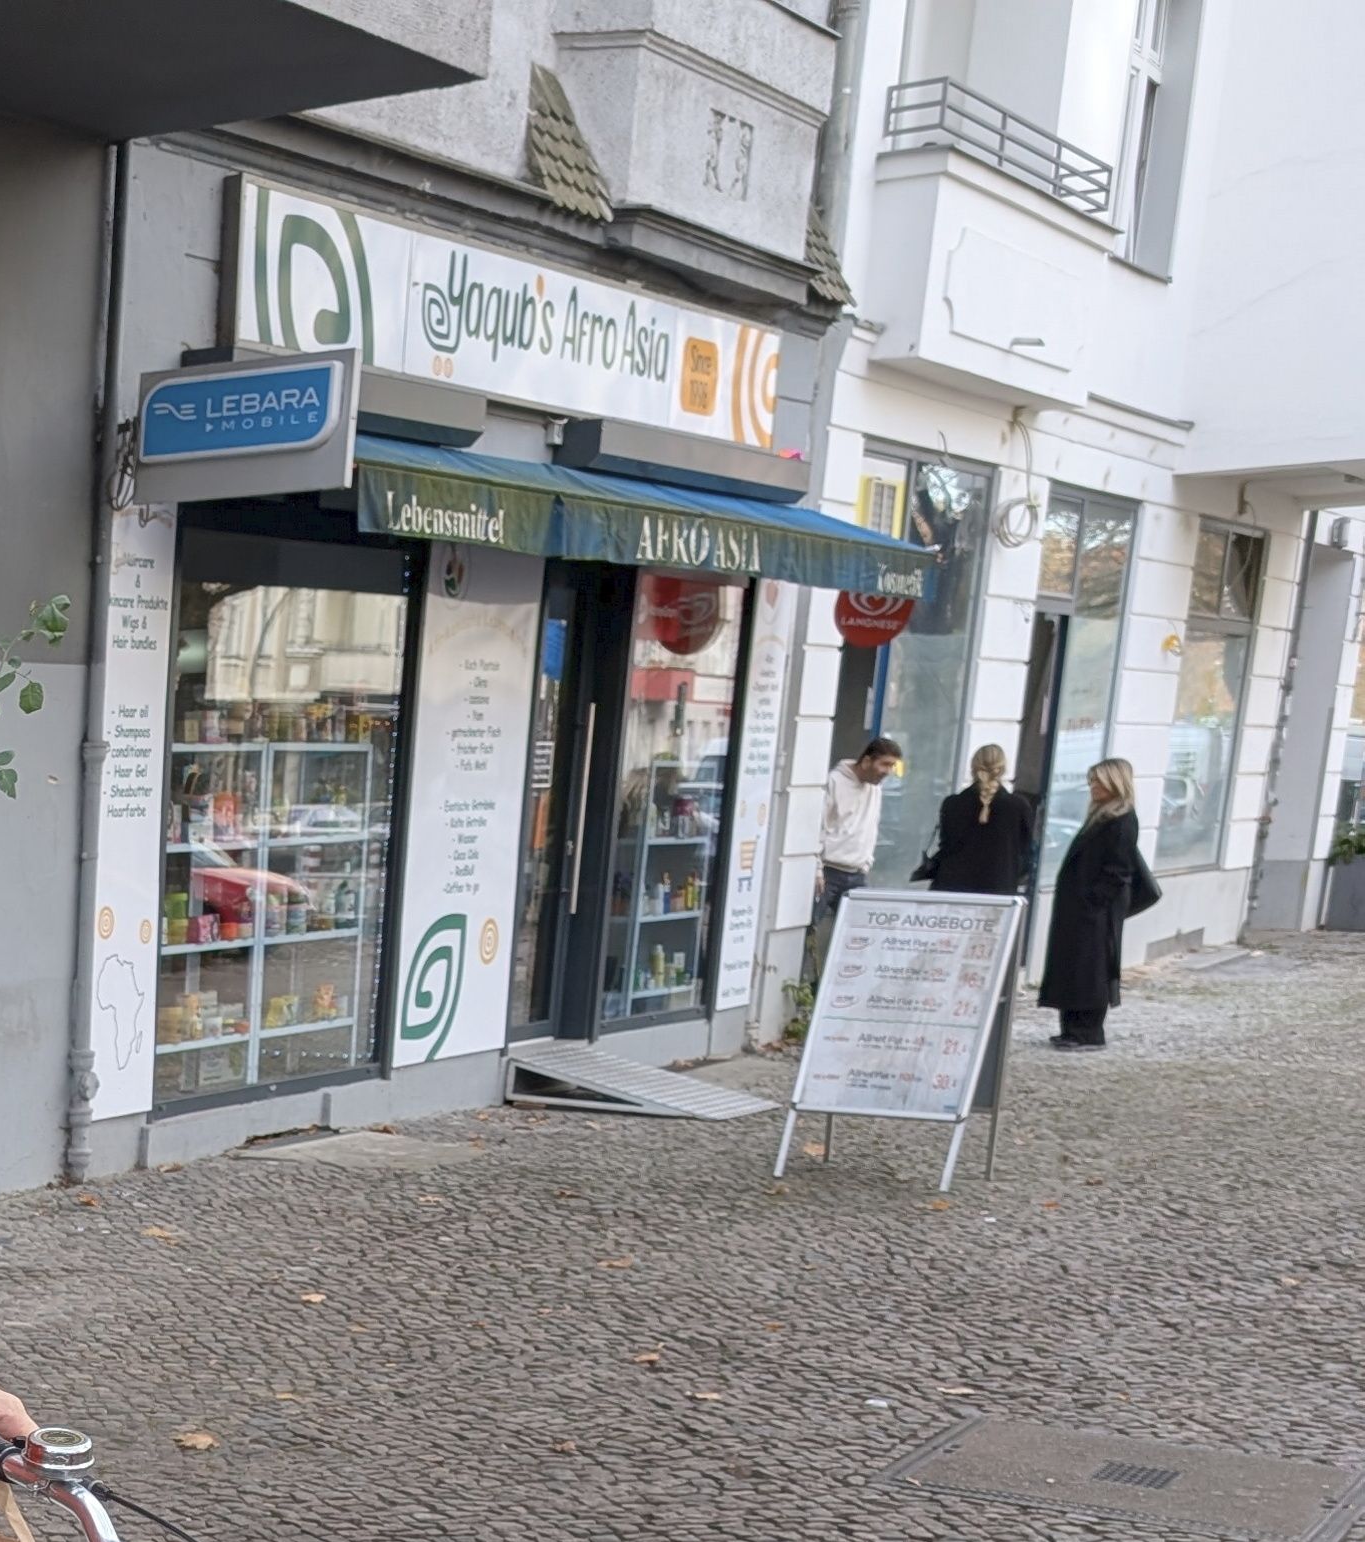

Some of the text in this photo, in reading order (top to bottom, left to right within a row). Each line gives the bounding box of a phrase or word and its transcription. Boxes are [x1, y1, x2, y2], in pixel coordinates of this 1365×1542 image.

[421, 250, 670, 383] Yaqub's Afro Asia
[205, 386, 320, 418] LEBARA
[221, 411, 319, 431] MOBILE
[386, 490, 505, 545] Lebensmittel
[635, 515, 762, 573] AFRO ASIA
[112, 634, 129, 650] Hair
[111, 744, 152, 759] conditioner
[110, 784, 153, 799] Sheabutter
[106, 803, 147, 818] Haarfarbe
[867, 911, 996, 933] TOP ANGEBOTE
